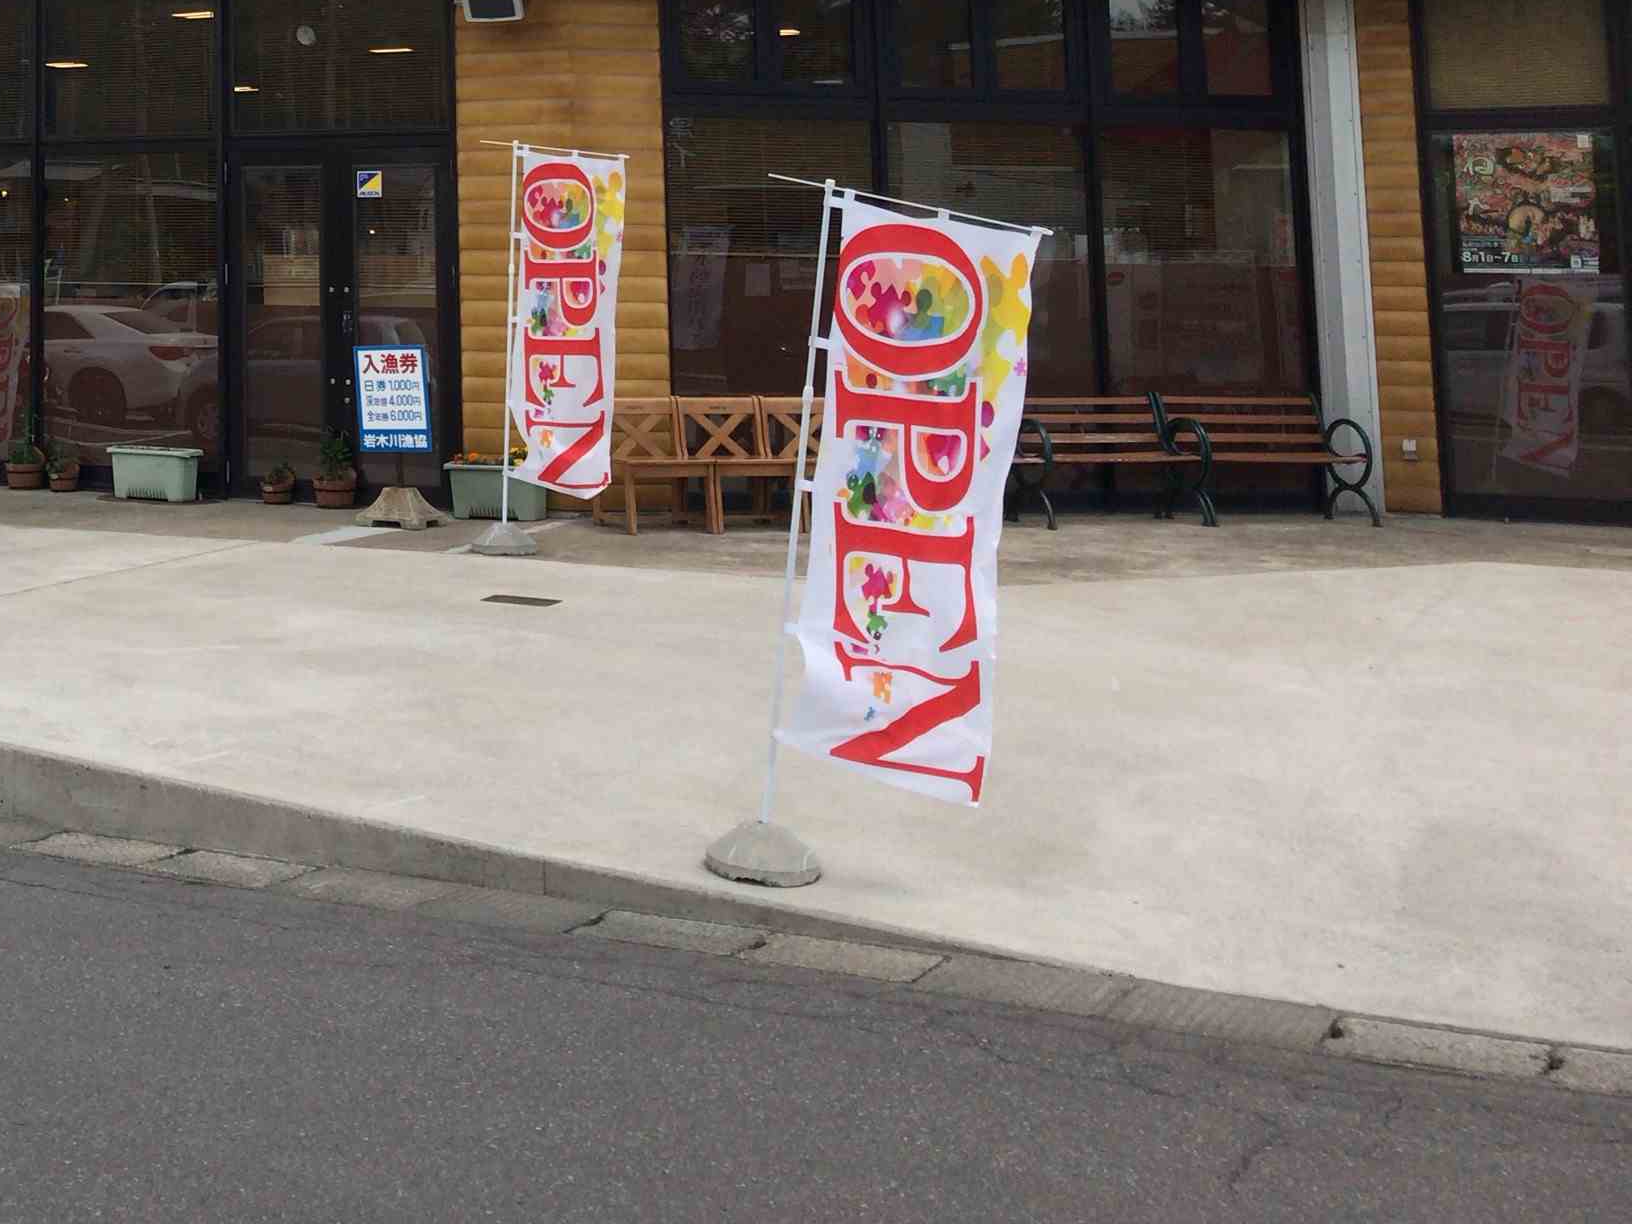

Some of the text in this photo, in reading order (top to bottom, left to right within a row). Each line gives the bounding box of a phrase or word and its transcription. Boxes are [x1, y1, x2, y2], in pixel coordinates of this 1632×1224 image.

[363, 353, 418, 374] 入漁券
[523, 162, 609, 489] OPEN
[830, 223, 985, 802] OPEN
